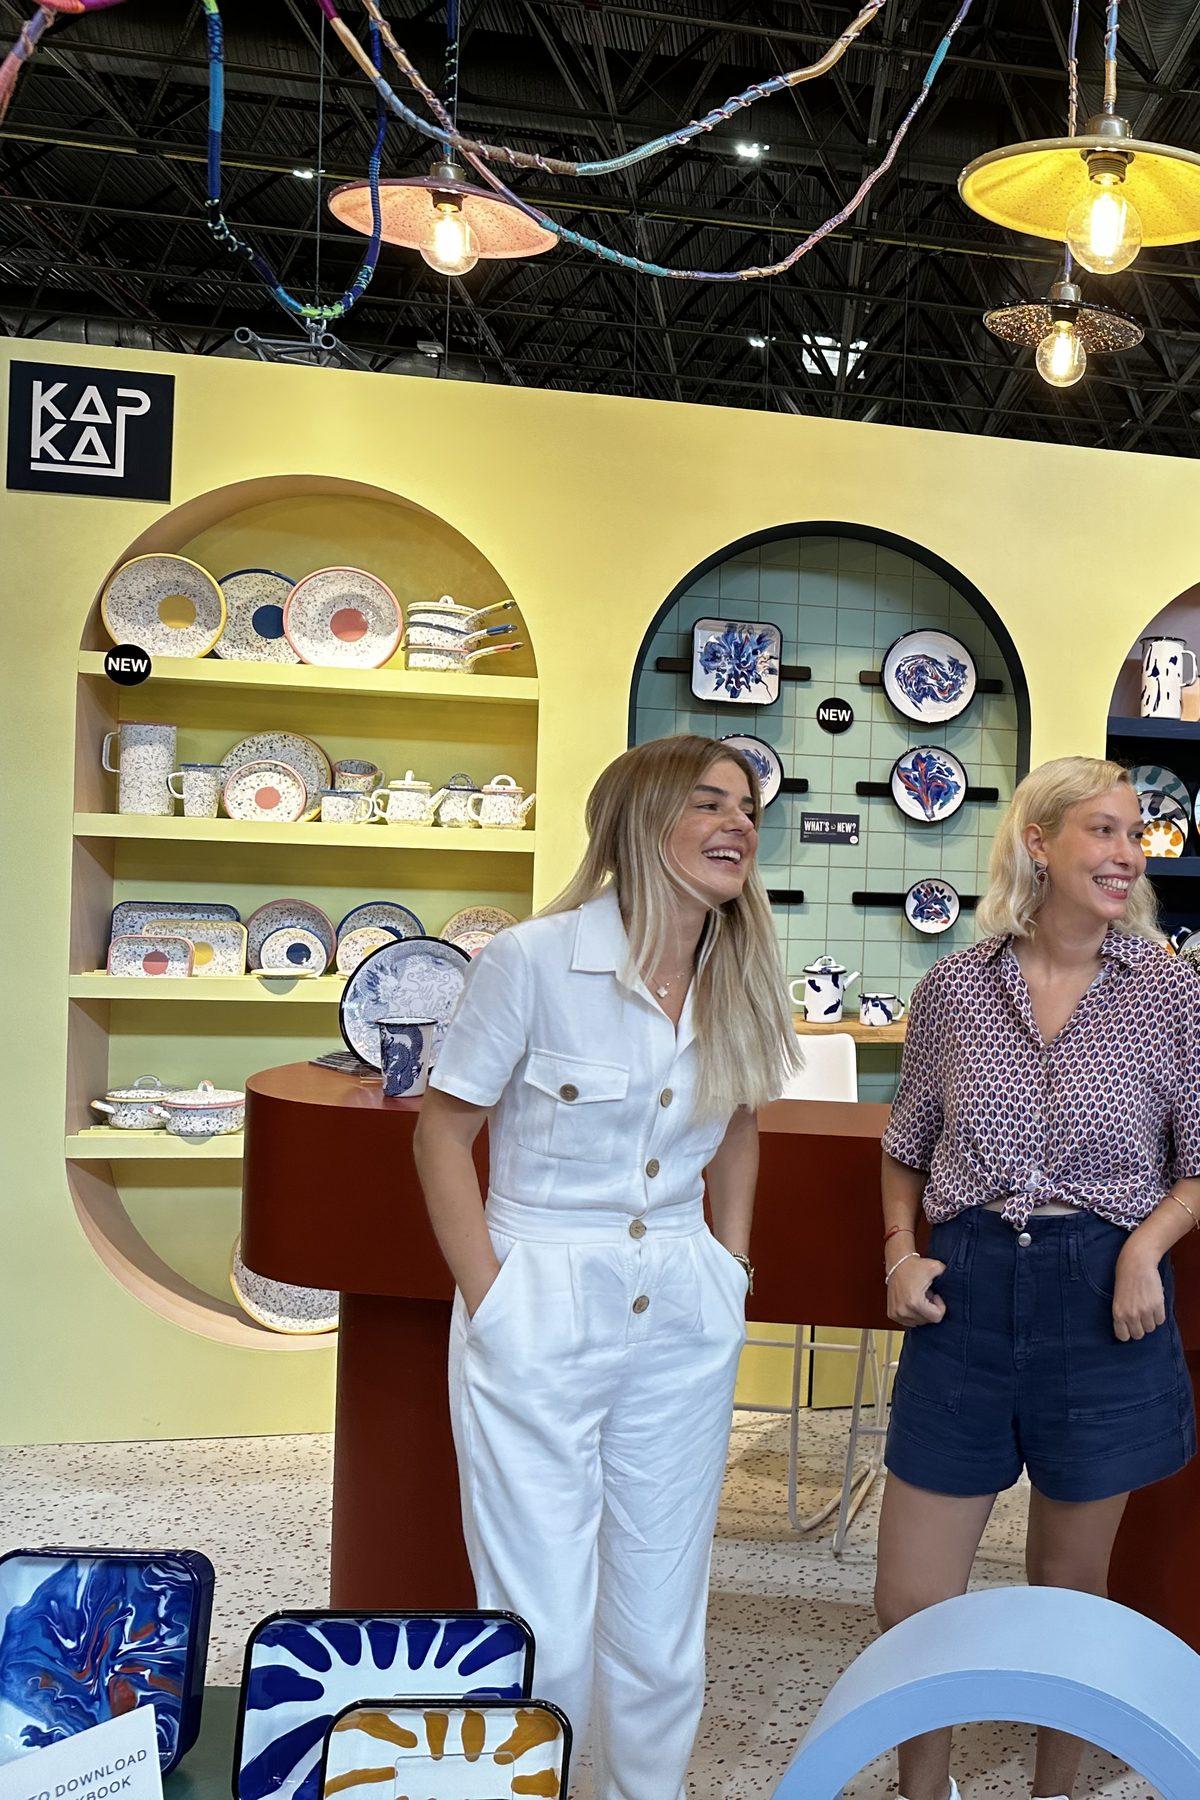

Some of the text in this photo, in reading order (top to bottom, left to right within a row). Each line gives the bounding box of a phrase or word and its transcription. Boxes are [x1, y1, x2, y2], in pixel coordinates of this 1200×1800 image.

[108, 657, 148, 673] NEW
[819, 708, 851, 722] NEW
[803, 820, 830, 832] WHAT'S
[836, 822, 857, 834] NEW?
[55, 1749, 147, 1798] DOWNLOAD
[76, 1775, 131, 1800] BOOK
